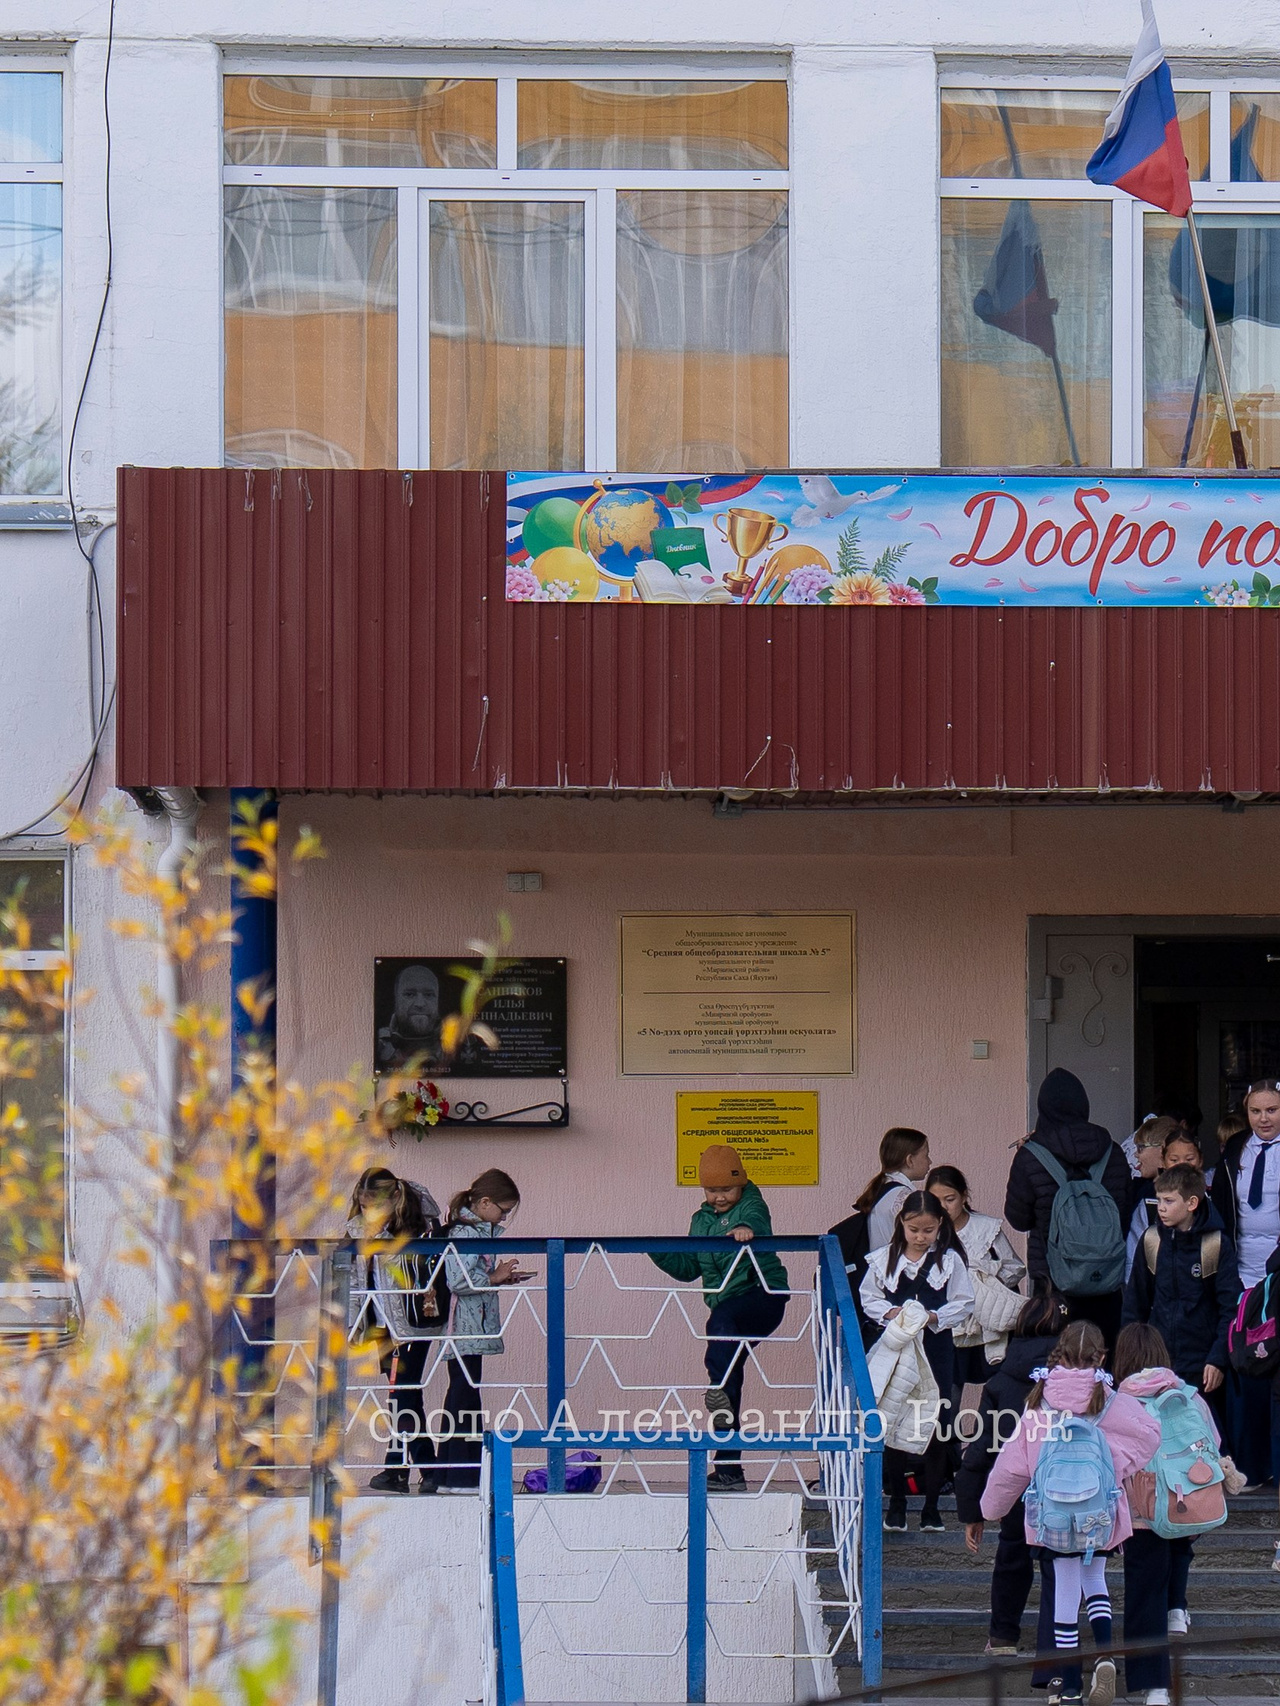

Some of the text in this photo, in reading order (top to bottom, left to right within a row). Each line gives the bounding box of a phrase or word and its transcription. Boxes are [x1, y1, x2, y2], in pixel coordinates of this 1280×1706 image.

[950, 487, 1177, 597] Добро
[685, 930, 744, 938] Муниципальное
[675, 939, 797, 948] общеобразовательное учреждение
[685, 949, 778, 958] общеобразовательная
[750, 974, 778, 982] (Якутия)
[493, 999, 525, 1008] ИЛЬЯ
[468, 1011, 553, 1021] ЕННАДЬЕВИЧ
[704, 1028, 733, 1037] уопсай
[789, 1029, 837, 1037] оскуолата»
[701, 1037, 727, 1046] уопсай
[668, 1046, 711, 1054] автономнай
[712, 1046, 768, 1056] муниципальнай
